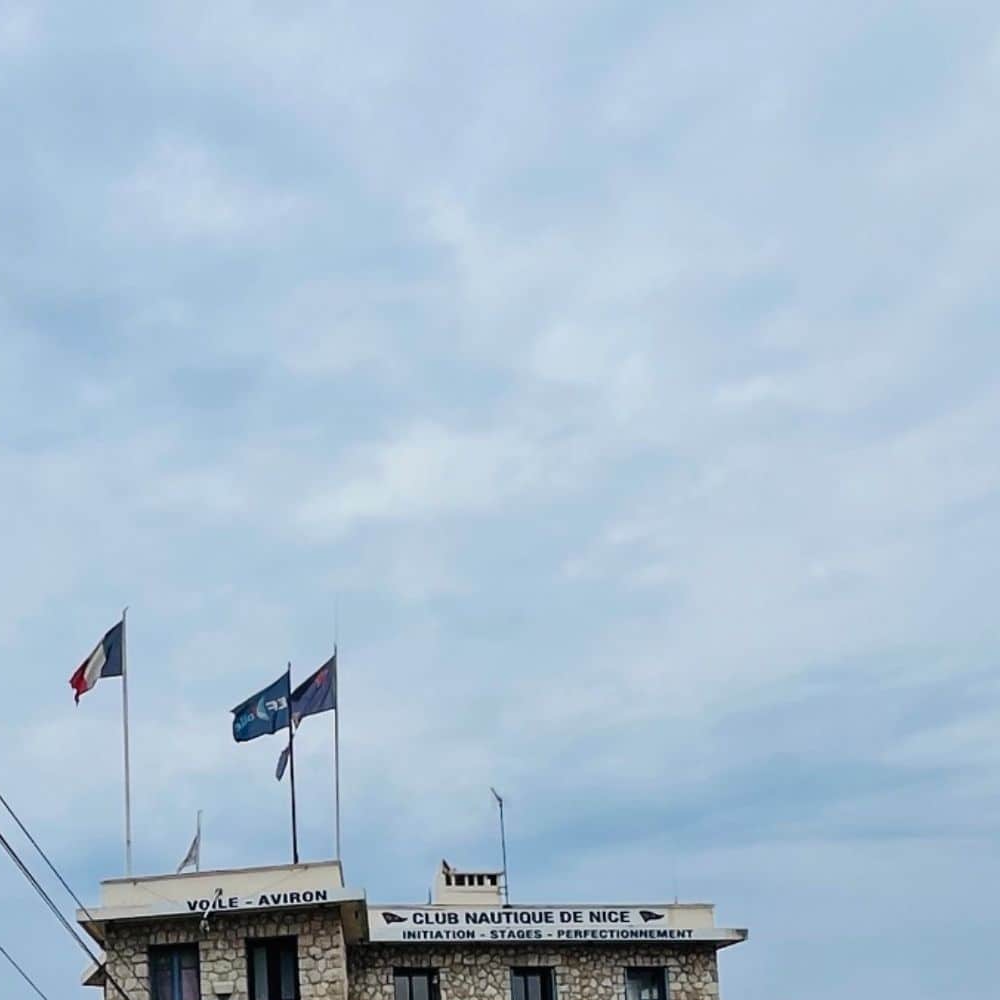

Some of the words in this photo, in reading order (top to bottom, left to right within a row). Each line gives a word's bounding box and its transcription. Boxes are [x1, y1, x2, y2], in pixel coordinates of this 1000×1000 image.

[187, 897, 239, 911] VOILE
[258, 890, 328, 906] AVIRON
[412, 912, 459, 925] CLUB
[465, 911, 555, 925] NAUTIQUE
[559, 911, 584, 923] DE
[589, 911, 631, 923] NICE
[402, 929, 476, 940] INITIATION
[490, 929, 542, 940] STAGES
[557, 929, 694, 939] PERFECTIONNEMENT
